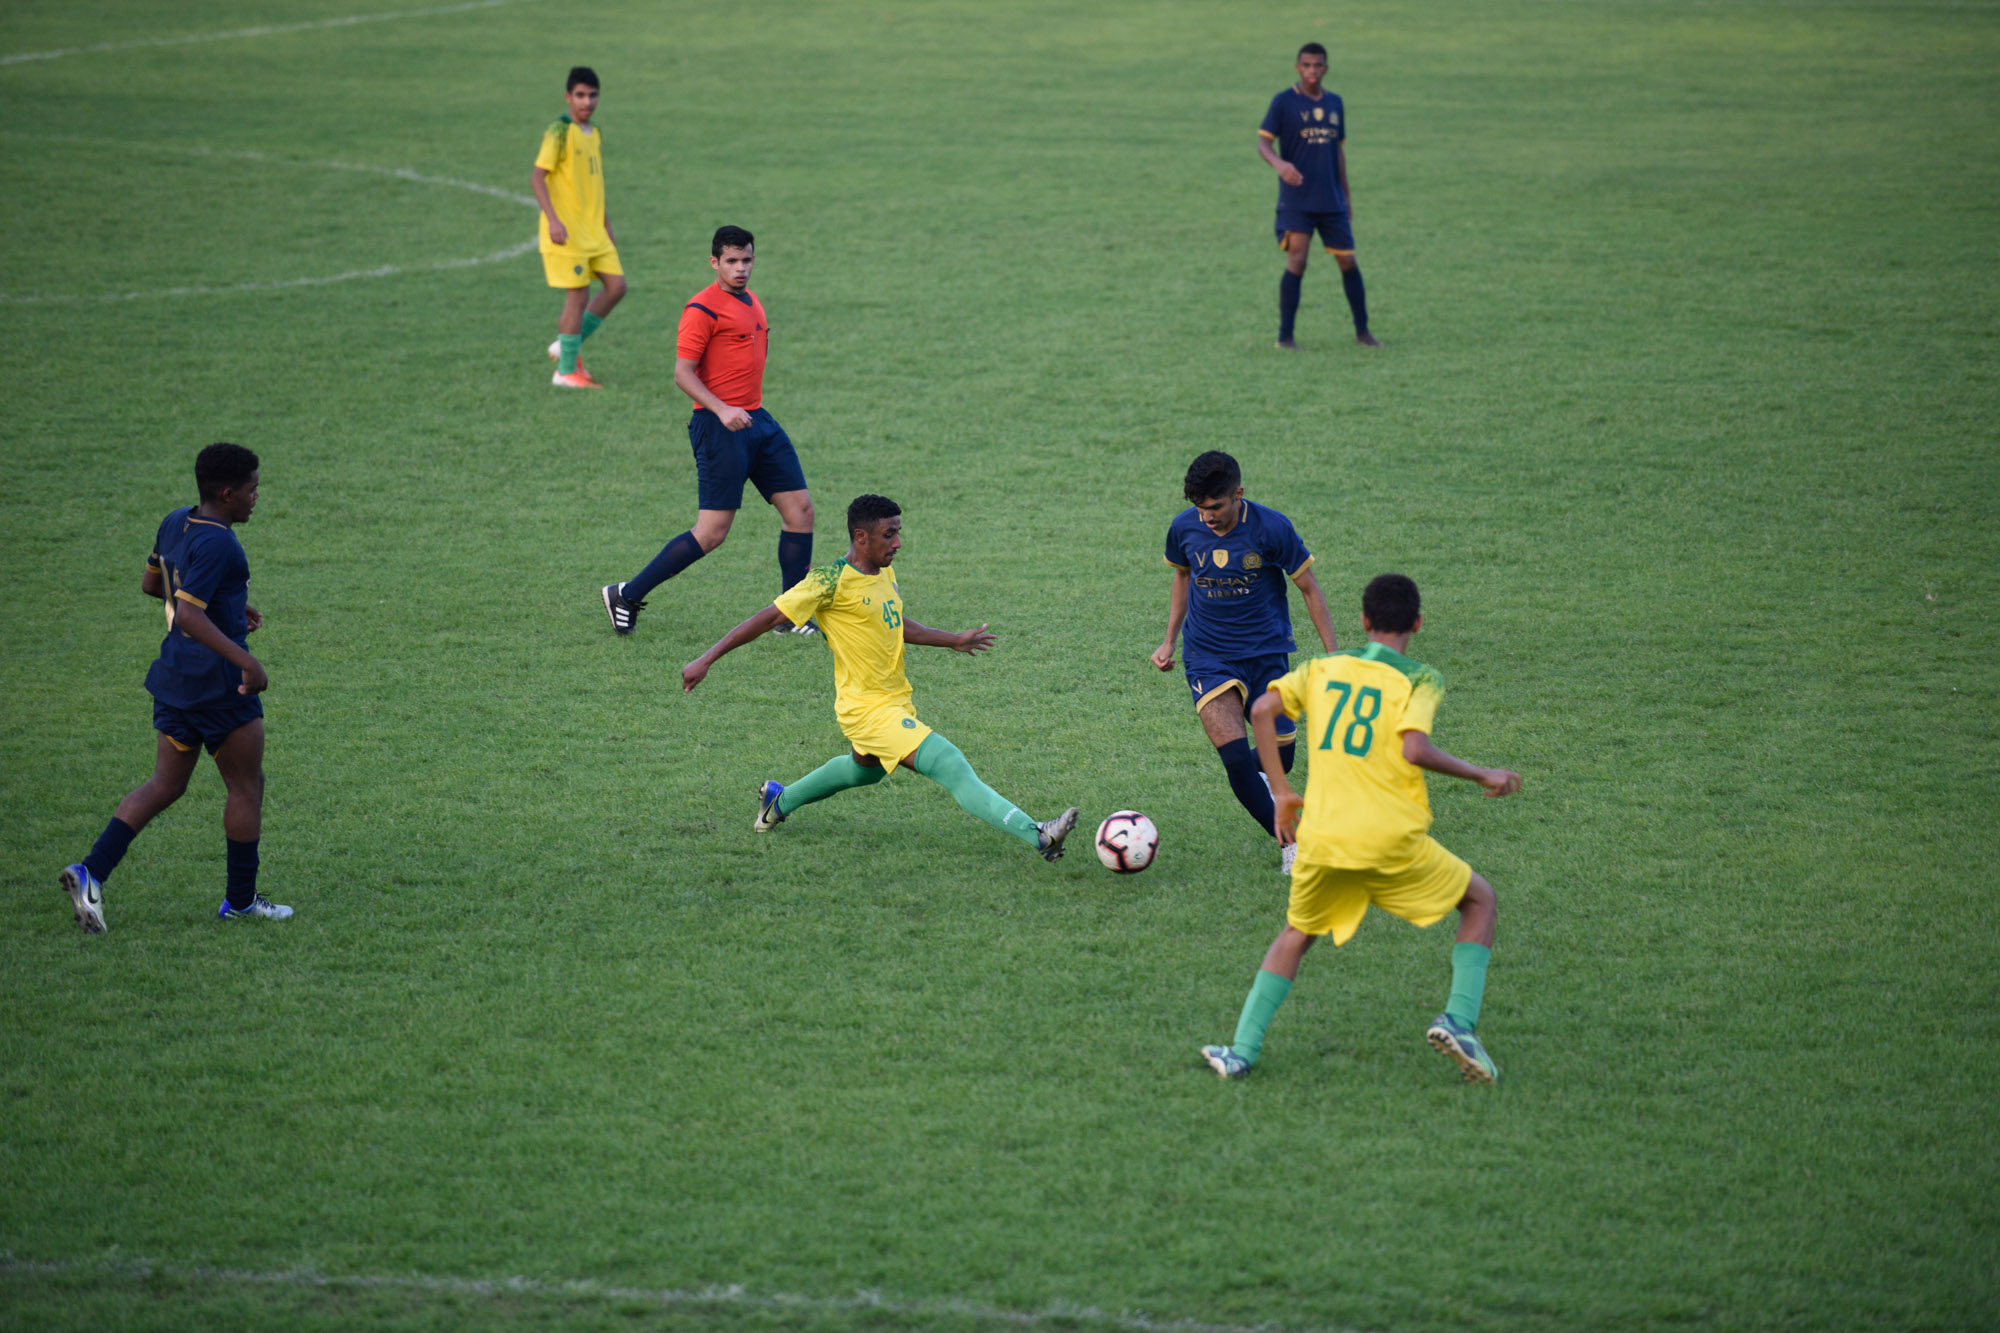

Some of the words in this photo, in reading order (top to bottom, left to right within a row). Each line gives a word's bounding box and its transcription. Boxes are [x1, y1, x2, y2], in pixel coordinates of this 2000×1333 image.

[1194, 573, 1258, 588] ETIHAD
[882, 599, 901, 629] 45
[1318, 680, 1382, 758] 78
